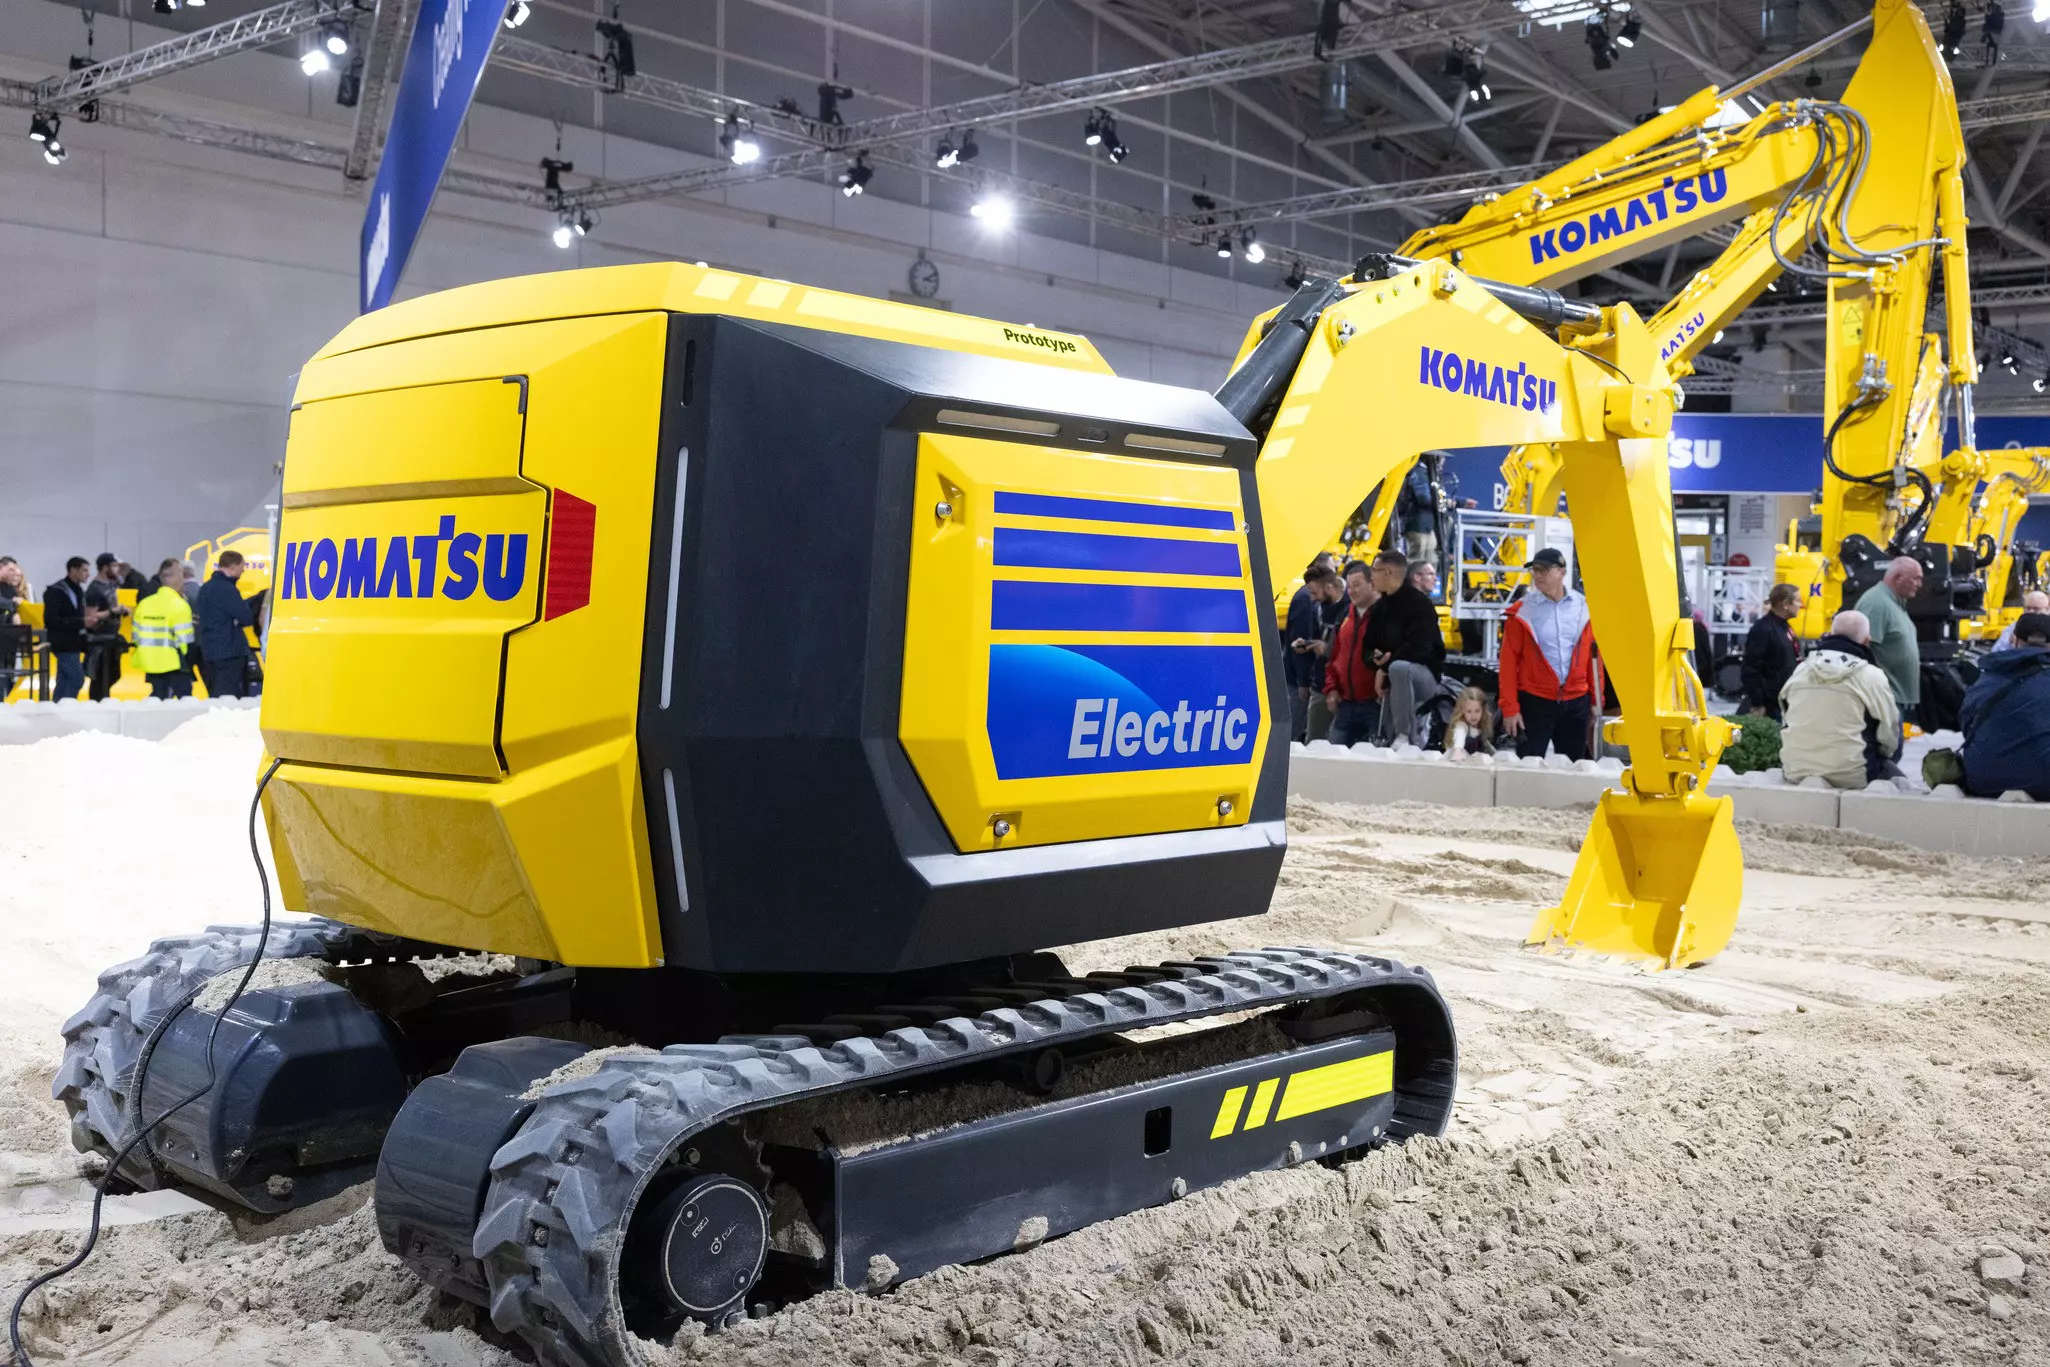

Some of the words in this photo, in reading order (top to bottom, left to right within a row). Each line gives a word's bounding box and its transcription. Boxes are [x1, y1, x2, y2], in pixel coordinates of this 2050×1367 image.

[1530, 168, 1727, 264] KOMATSU
[1003, 327, 1076, 353] Prototype
[1661, 312, 1705, 360] MATSU
[1419, 346, 1556, 415] KOMATSU
[282, 514, 528, 601] KOMATSU
[1068, 695, 1248, 760] Electric
